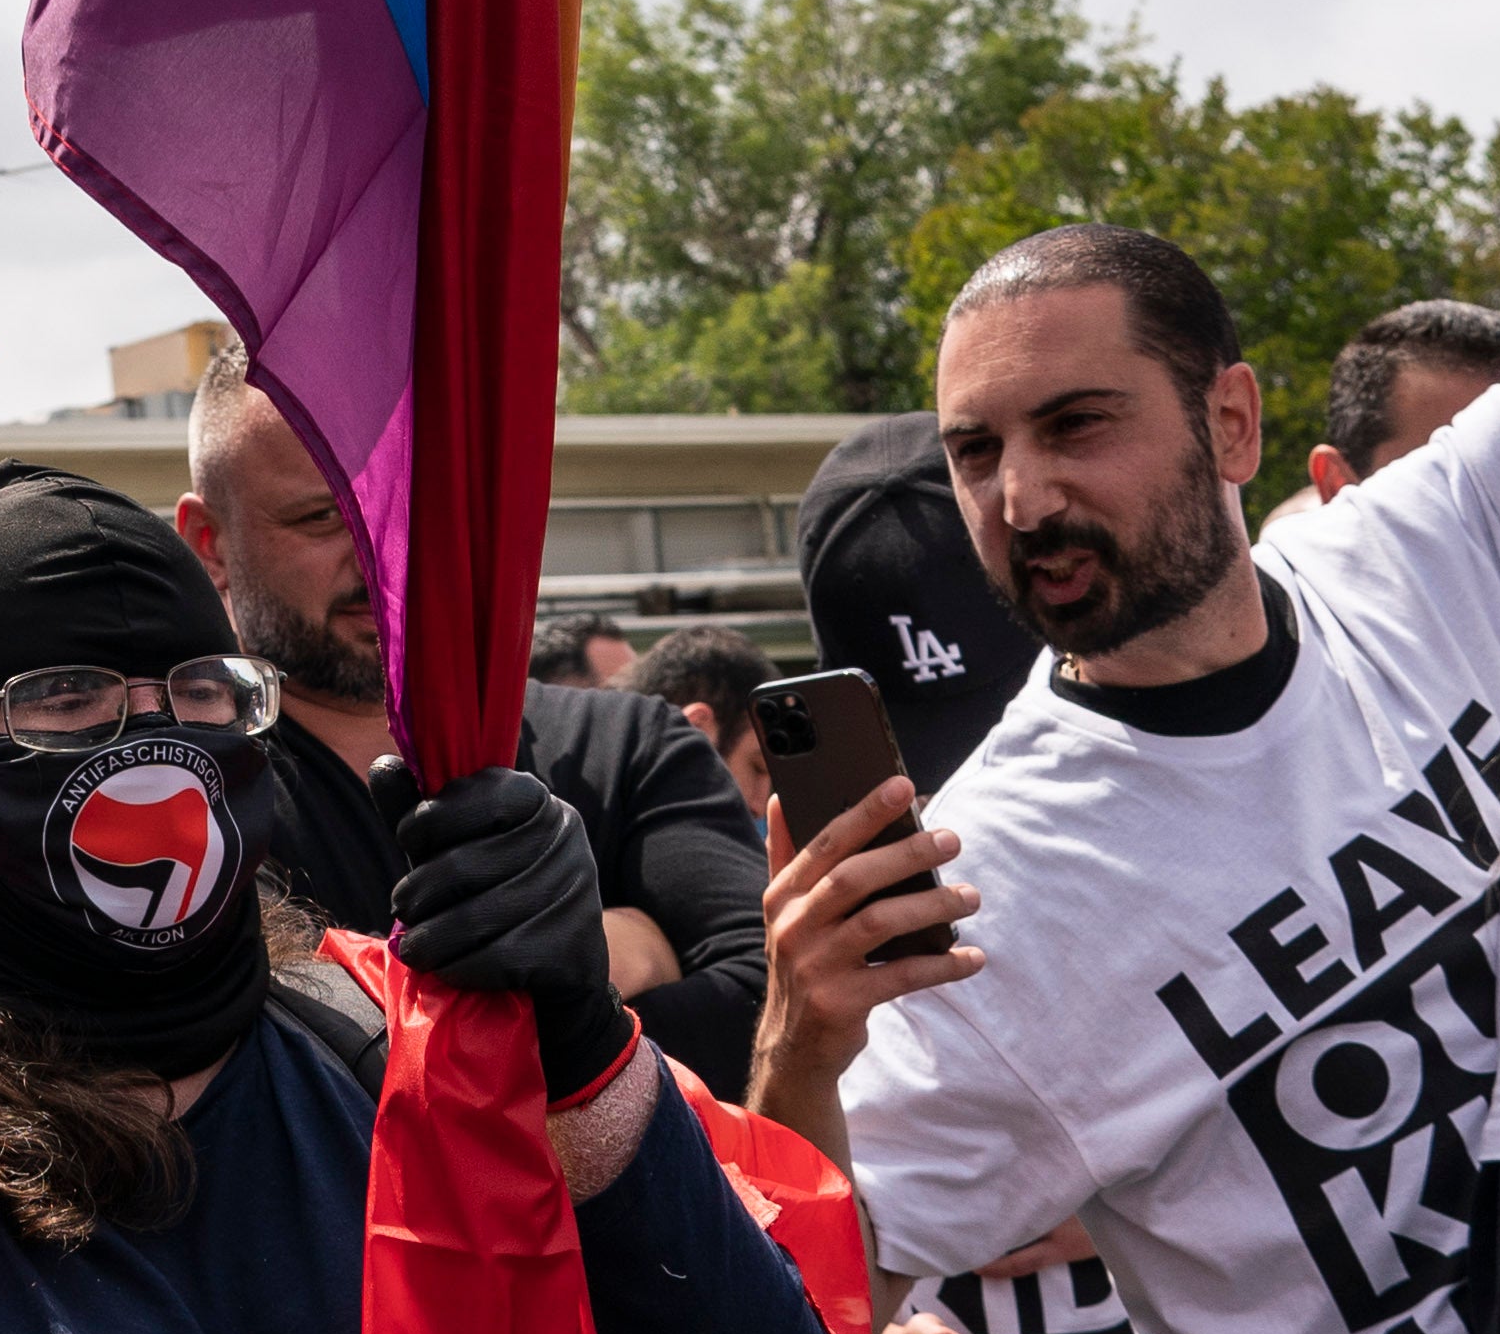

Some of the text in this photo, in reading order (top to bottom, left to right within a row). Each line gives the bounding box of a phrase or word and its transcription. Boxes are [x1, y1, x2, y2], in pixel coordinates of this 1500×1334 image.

[888, 615, 966, 683] LA
[61, 745, 221, 814] ANTIFASCHISTISCHE
[110, 926, 185, 945] AKTION
